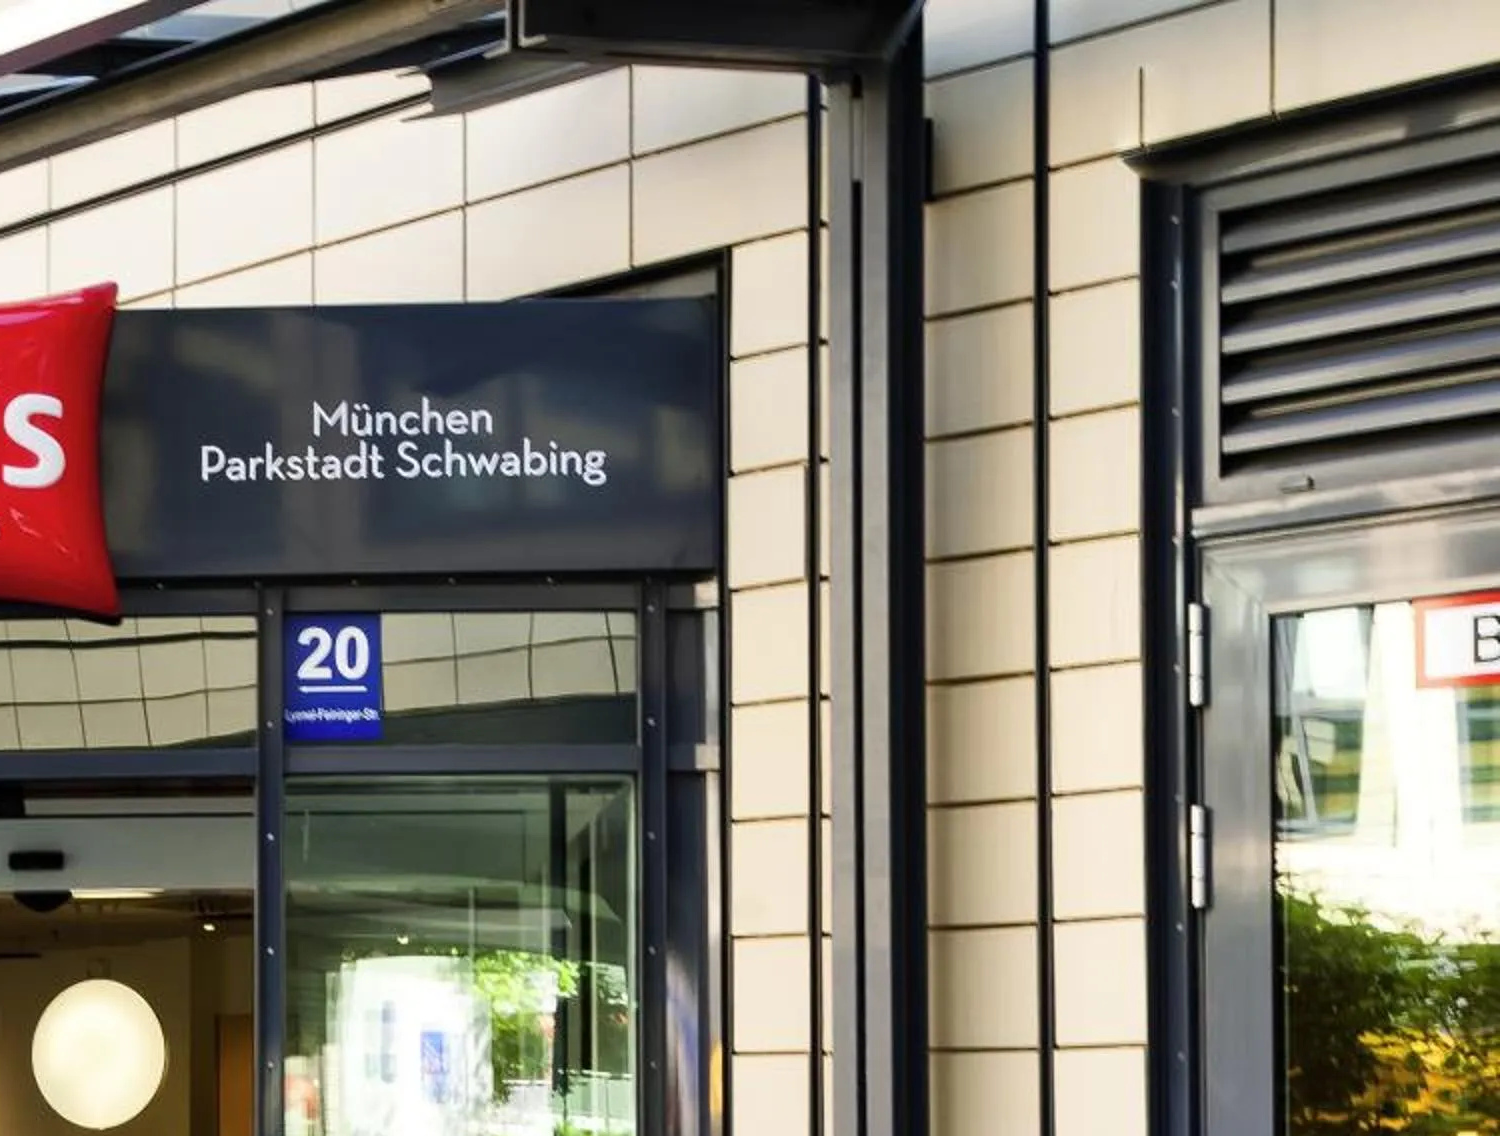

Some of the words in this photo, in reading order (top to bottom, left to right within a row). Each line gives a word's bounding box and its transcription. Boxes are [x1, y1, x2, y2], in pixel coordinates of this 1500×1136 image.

[312, 395, 493, 437] München
[200, 439, 385, 482] Parkstadt
[395, 437, 608, 486] Schwabing
[296, 625, 370, 681] 20
